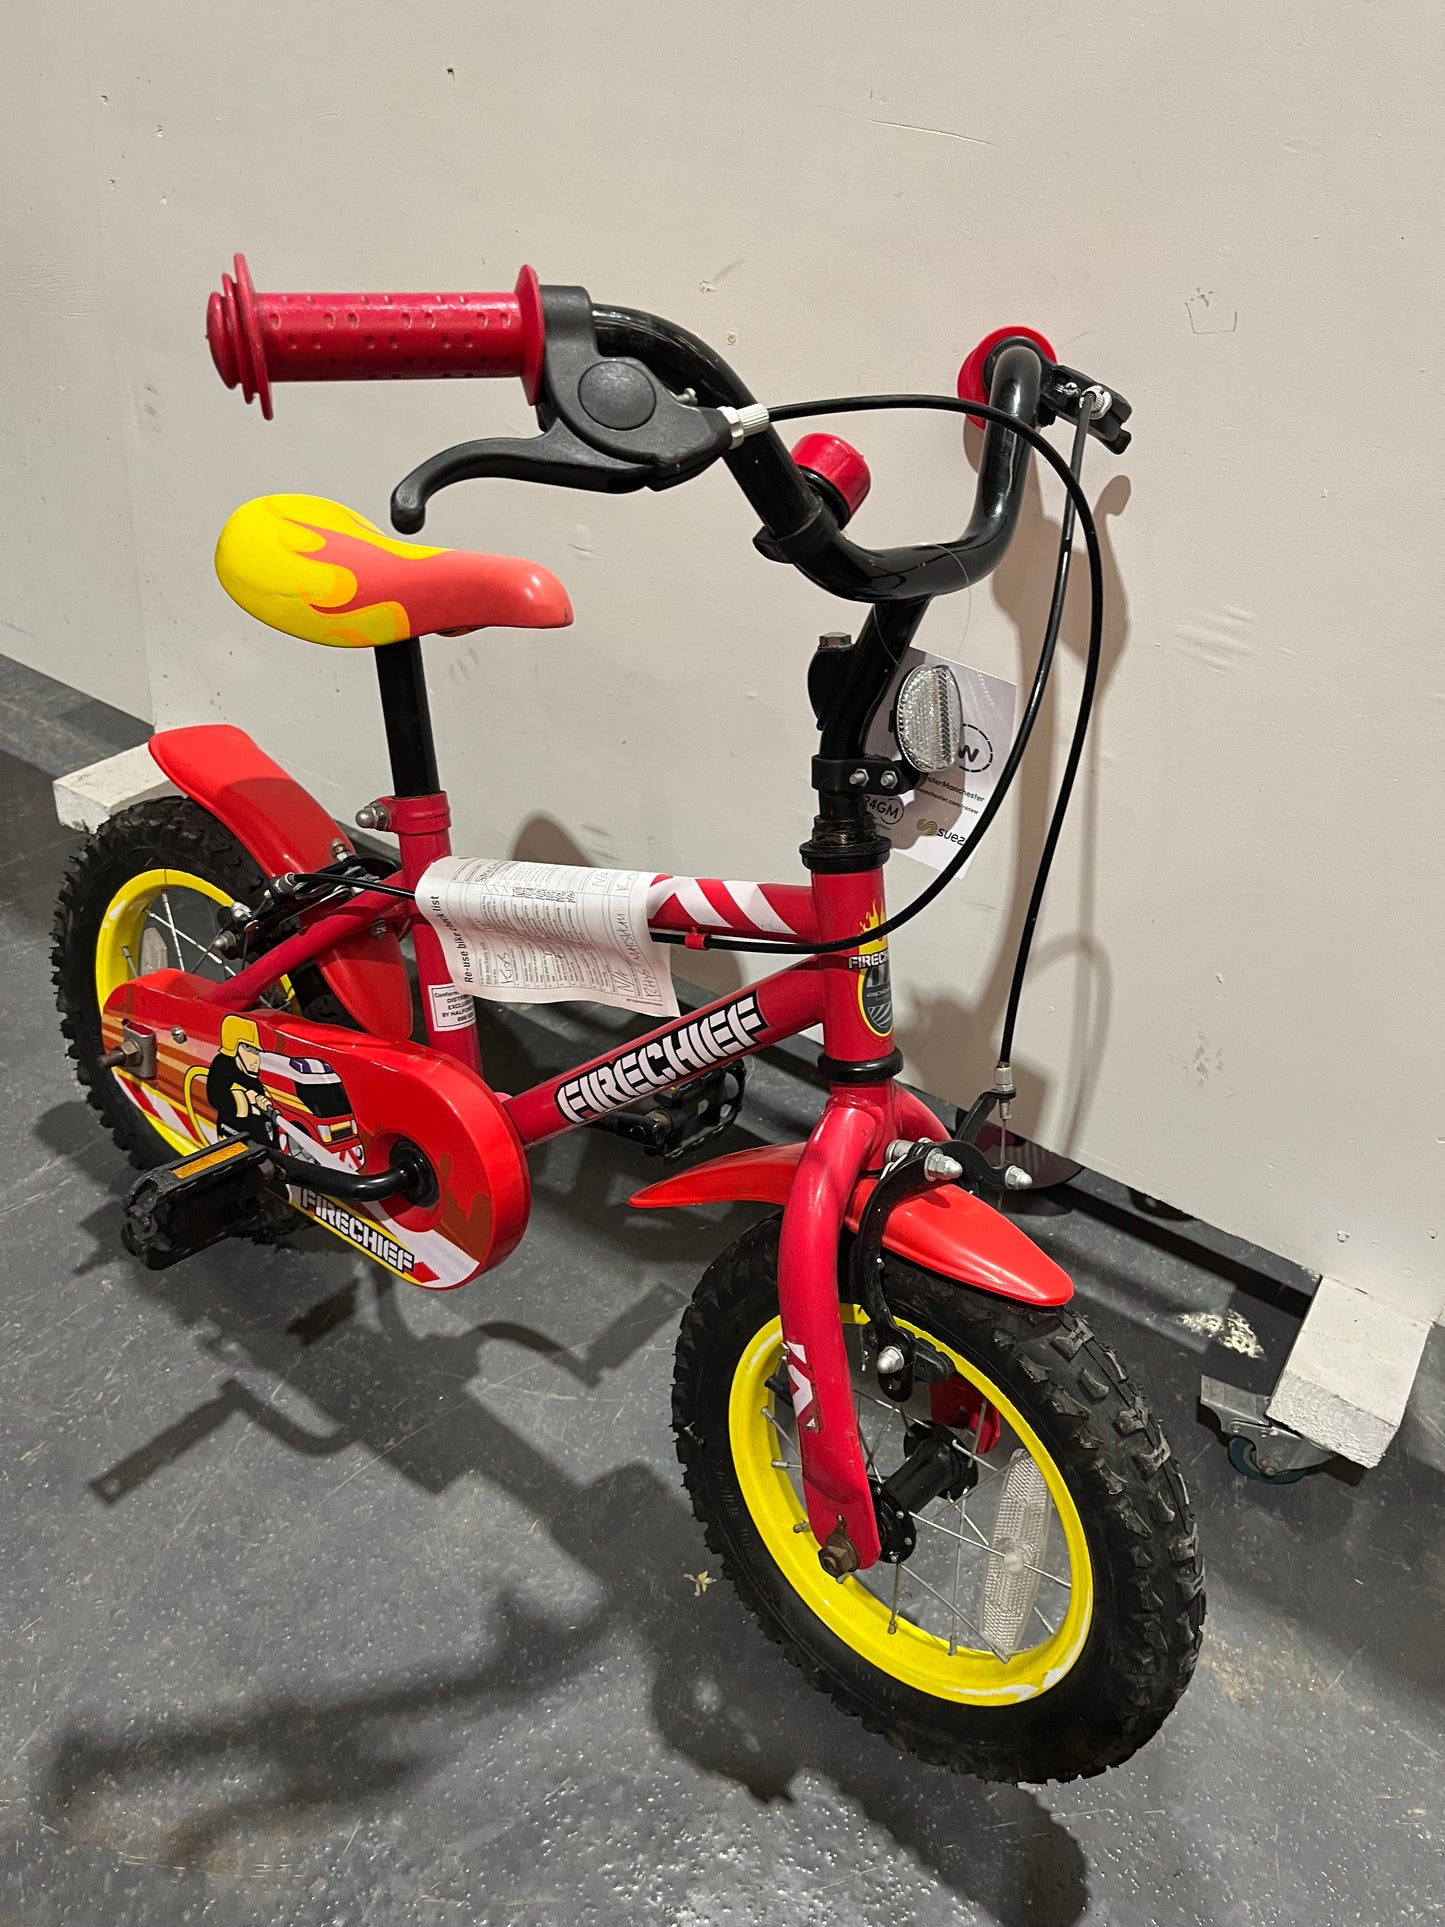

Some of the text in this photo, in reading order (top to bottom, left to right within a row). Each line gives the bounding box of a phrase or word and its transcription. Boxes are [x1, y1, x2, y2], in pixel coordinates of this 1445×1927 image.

[430, 896, 442, 912] list
[453, 932, 467, 949] bike
[461, 951, 474, 983] Re-use
[849, 950, 888, 969] FIREC
[556, 996, 762, 1123] FIRECHIEF
[302, 1187, 414, 1271] FIRECHIEF
